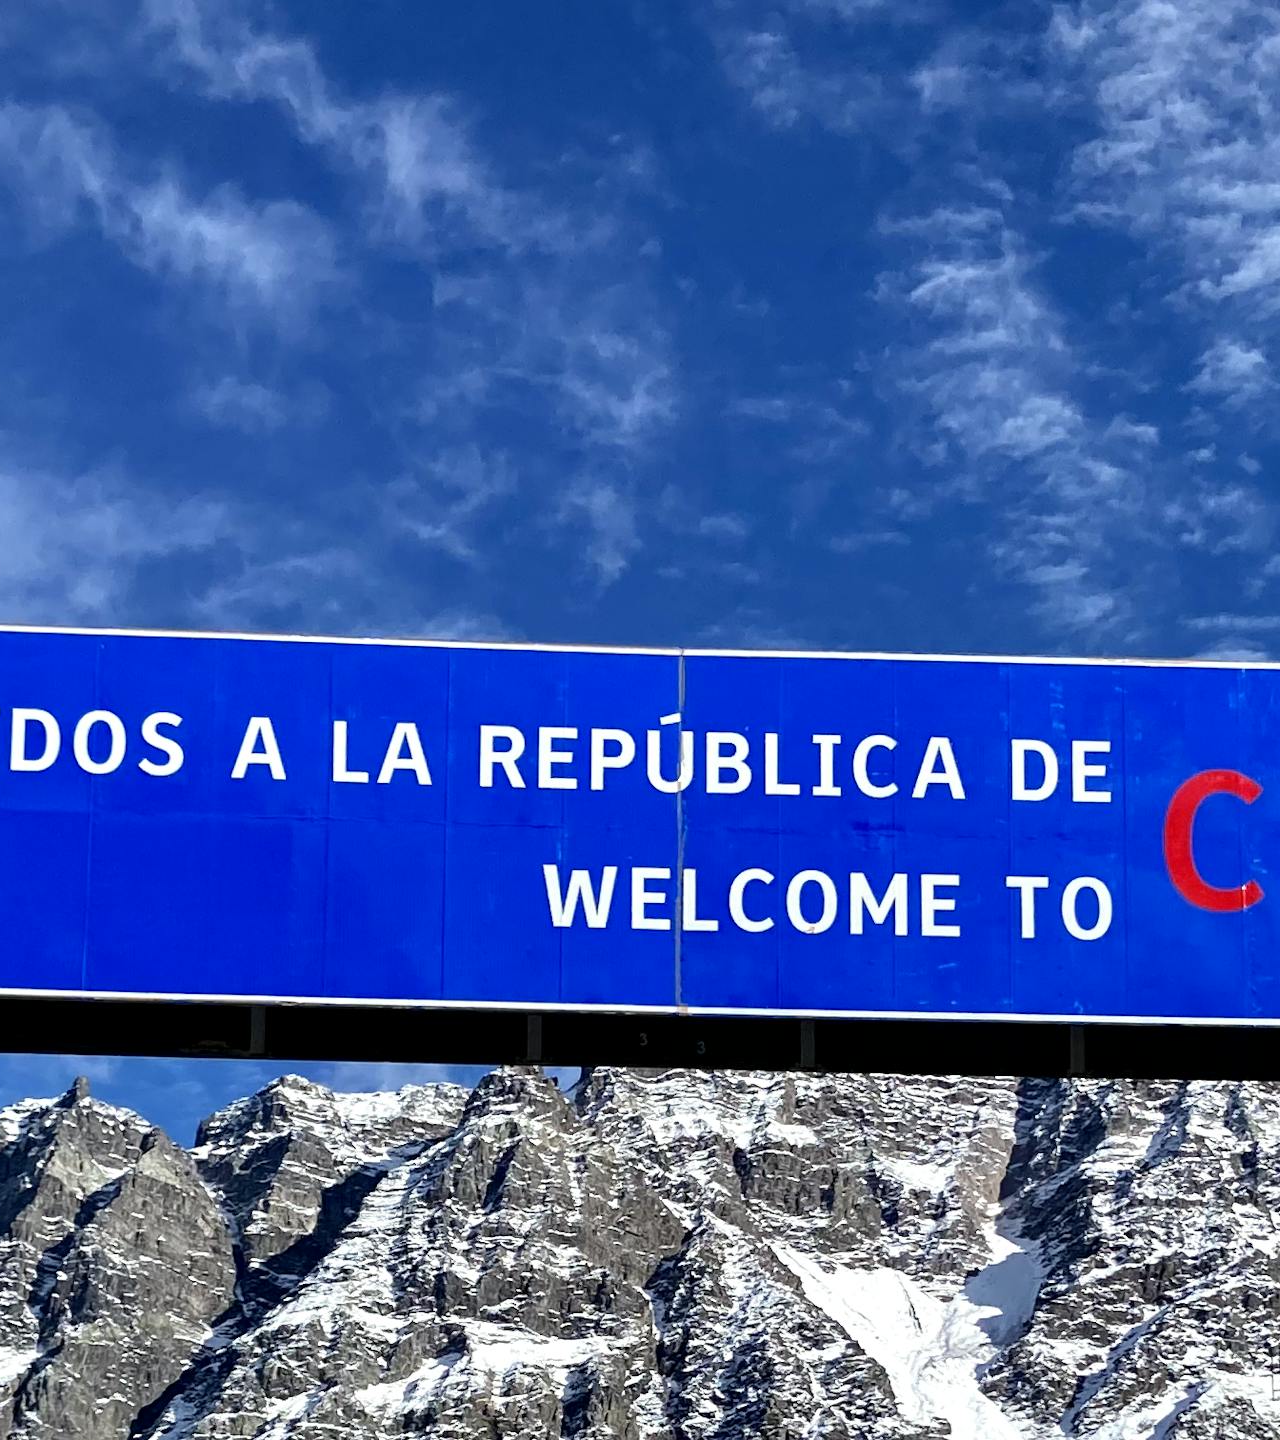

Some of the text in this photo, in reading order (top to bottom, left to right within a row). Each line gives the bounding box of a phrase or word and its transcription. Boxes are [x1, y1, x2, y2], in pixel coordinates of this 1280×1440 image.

[230, 716, 287, 780] A
[332, 720, 433, 786] LA
[479, 712, 966, 800] REPÚBLICA
[1011, 738, 1112, 803] DE
[542, 864, 1113, 941] WELCOME TO
